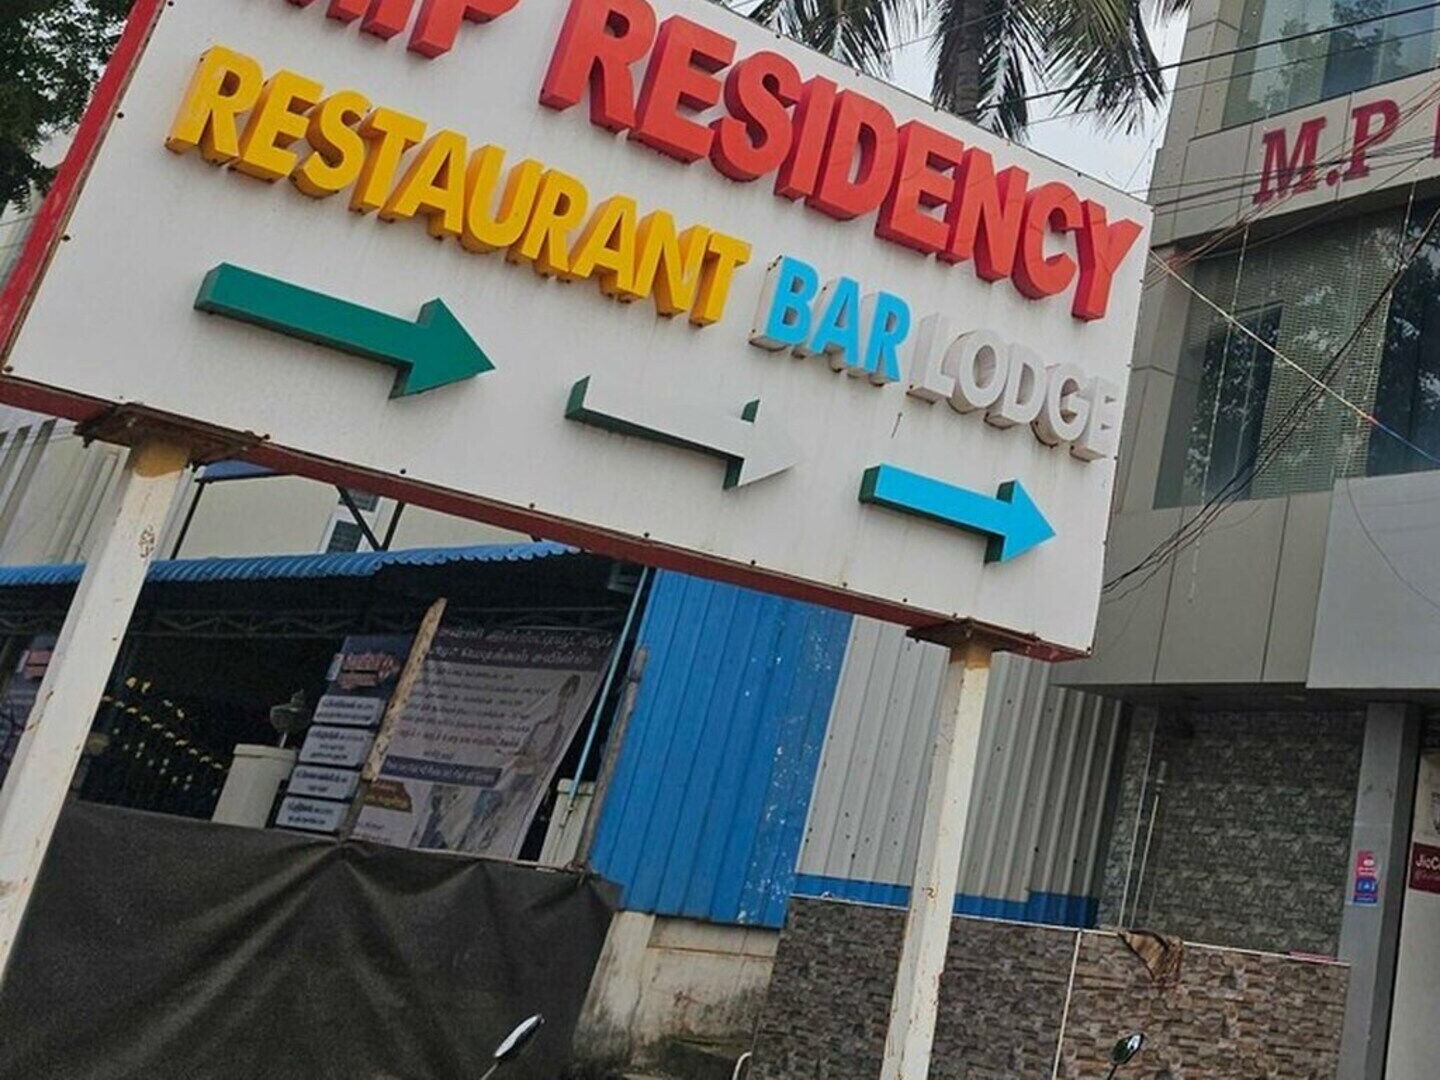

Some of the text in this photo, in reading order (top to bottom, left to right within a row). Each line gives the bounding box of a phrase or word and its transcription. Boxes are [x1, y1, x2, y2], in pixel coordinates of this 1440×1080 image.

[164, 44, 1120, 462] RESTAURANT BAR LODGE
[1253, 99, 1401, 206] M.P
